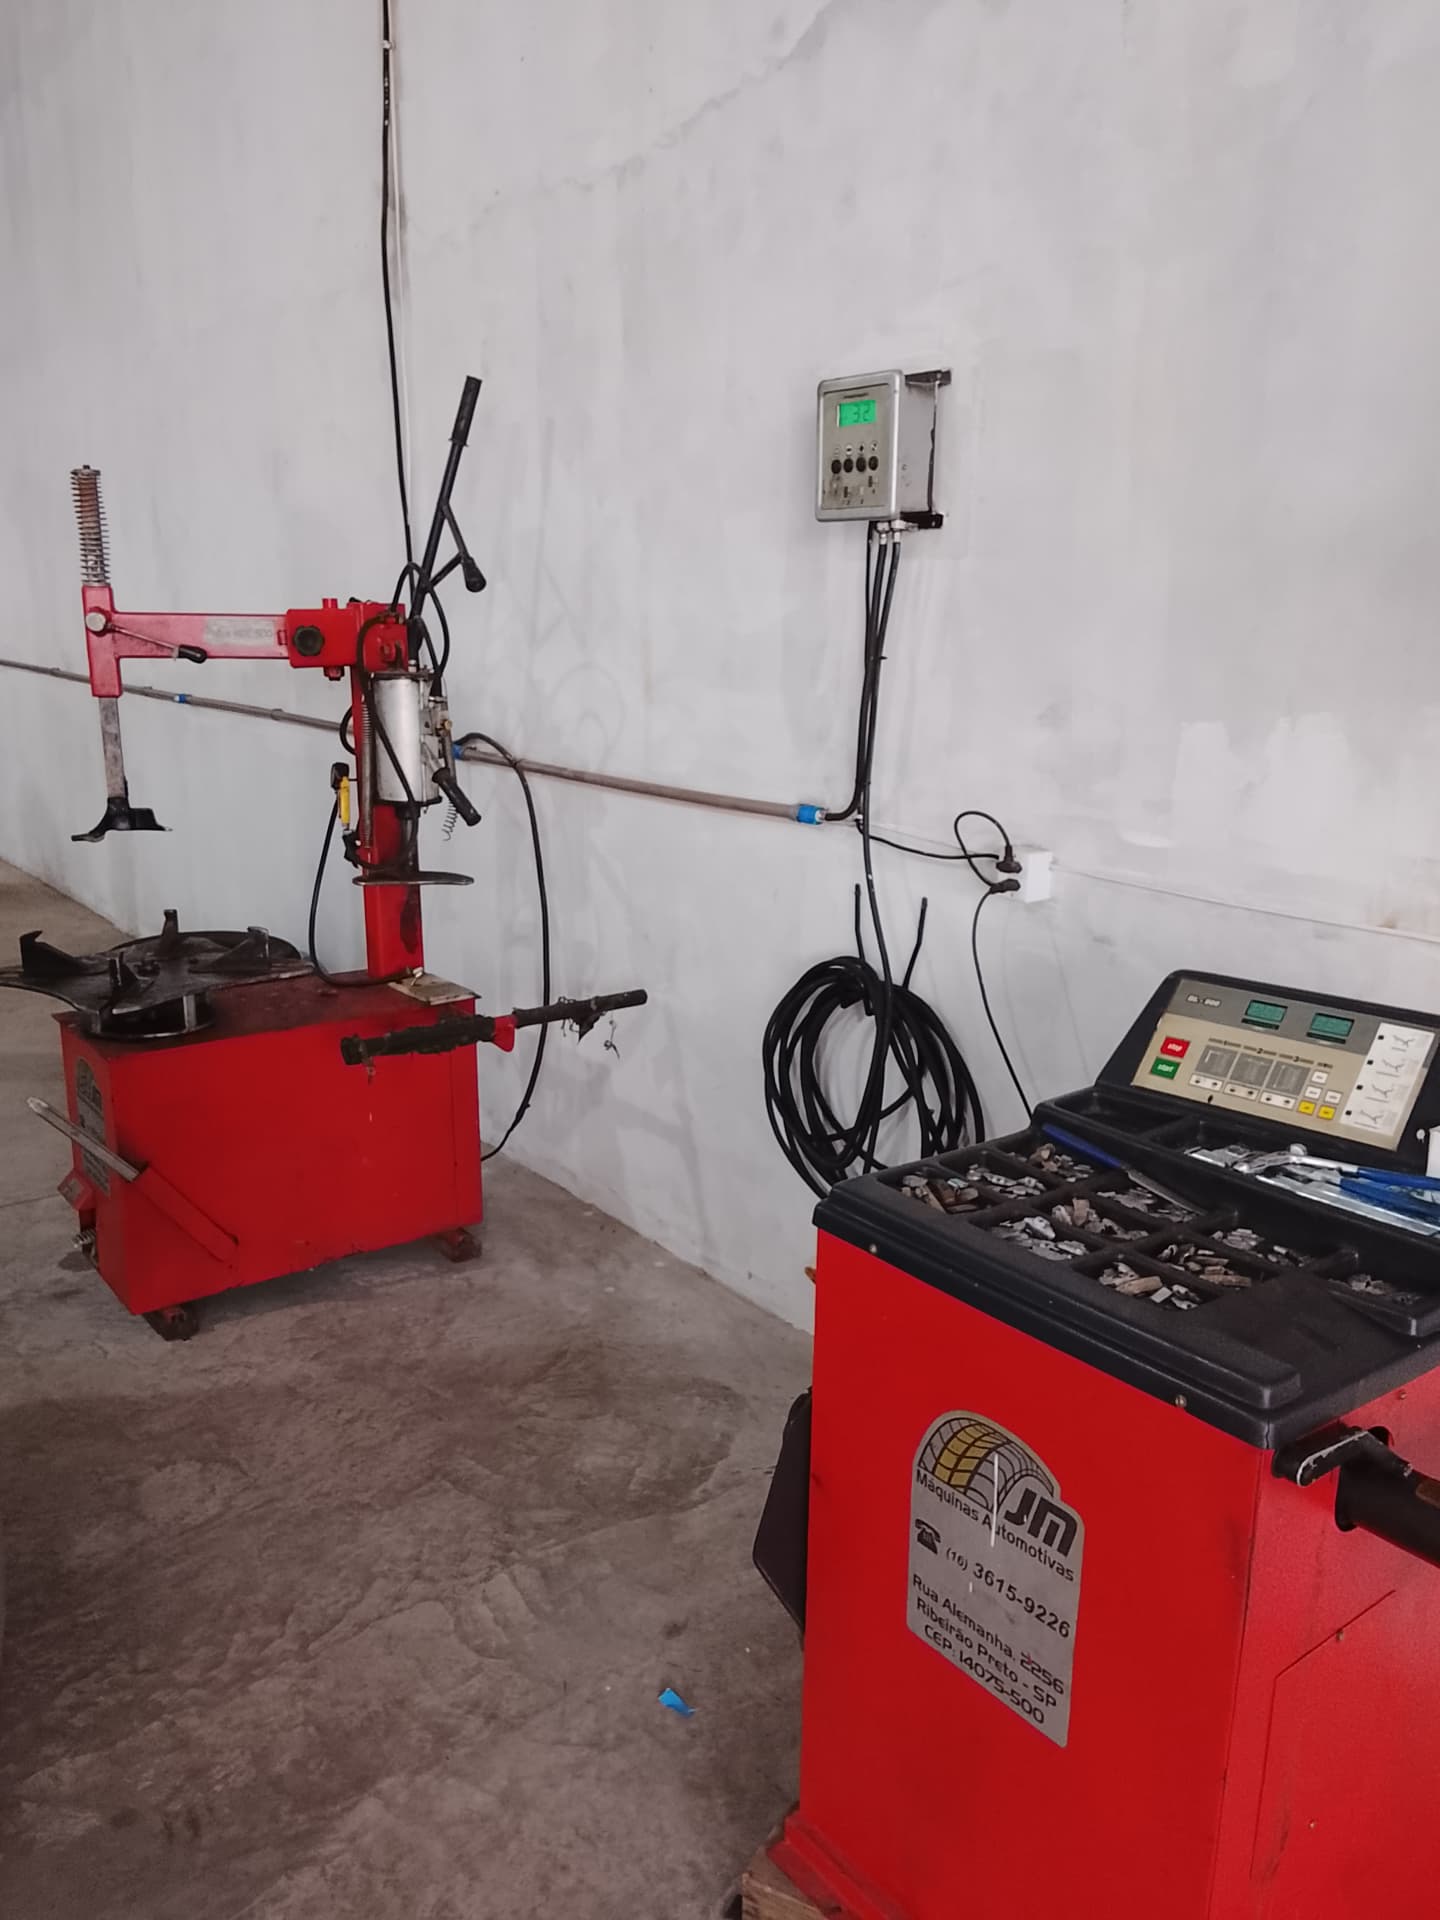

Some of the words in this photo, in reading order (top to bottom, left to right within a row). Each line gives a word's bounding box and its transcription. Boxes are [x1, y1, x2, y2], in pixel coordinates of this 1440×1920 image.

[915, 1468, 979, 1522] Máquinas
[981, 1514, 1075, 1582] Automotivas
[912, 1573, 939, 1604] Rua
[1020, 1651, 1065, 1696] 2256
[945, 1547, 969, 1572] (16)
[972, 1562, 1072, 1639] 3615-9226
[916, 1596, 974, 1650] Ribeirão
[977, 1643, 1019, 1684] Preto
[1033, 1684, 1058, 1708] SP
[958, 1649, 1045, 1725] 14075-500
